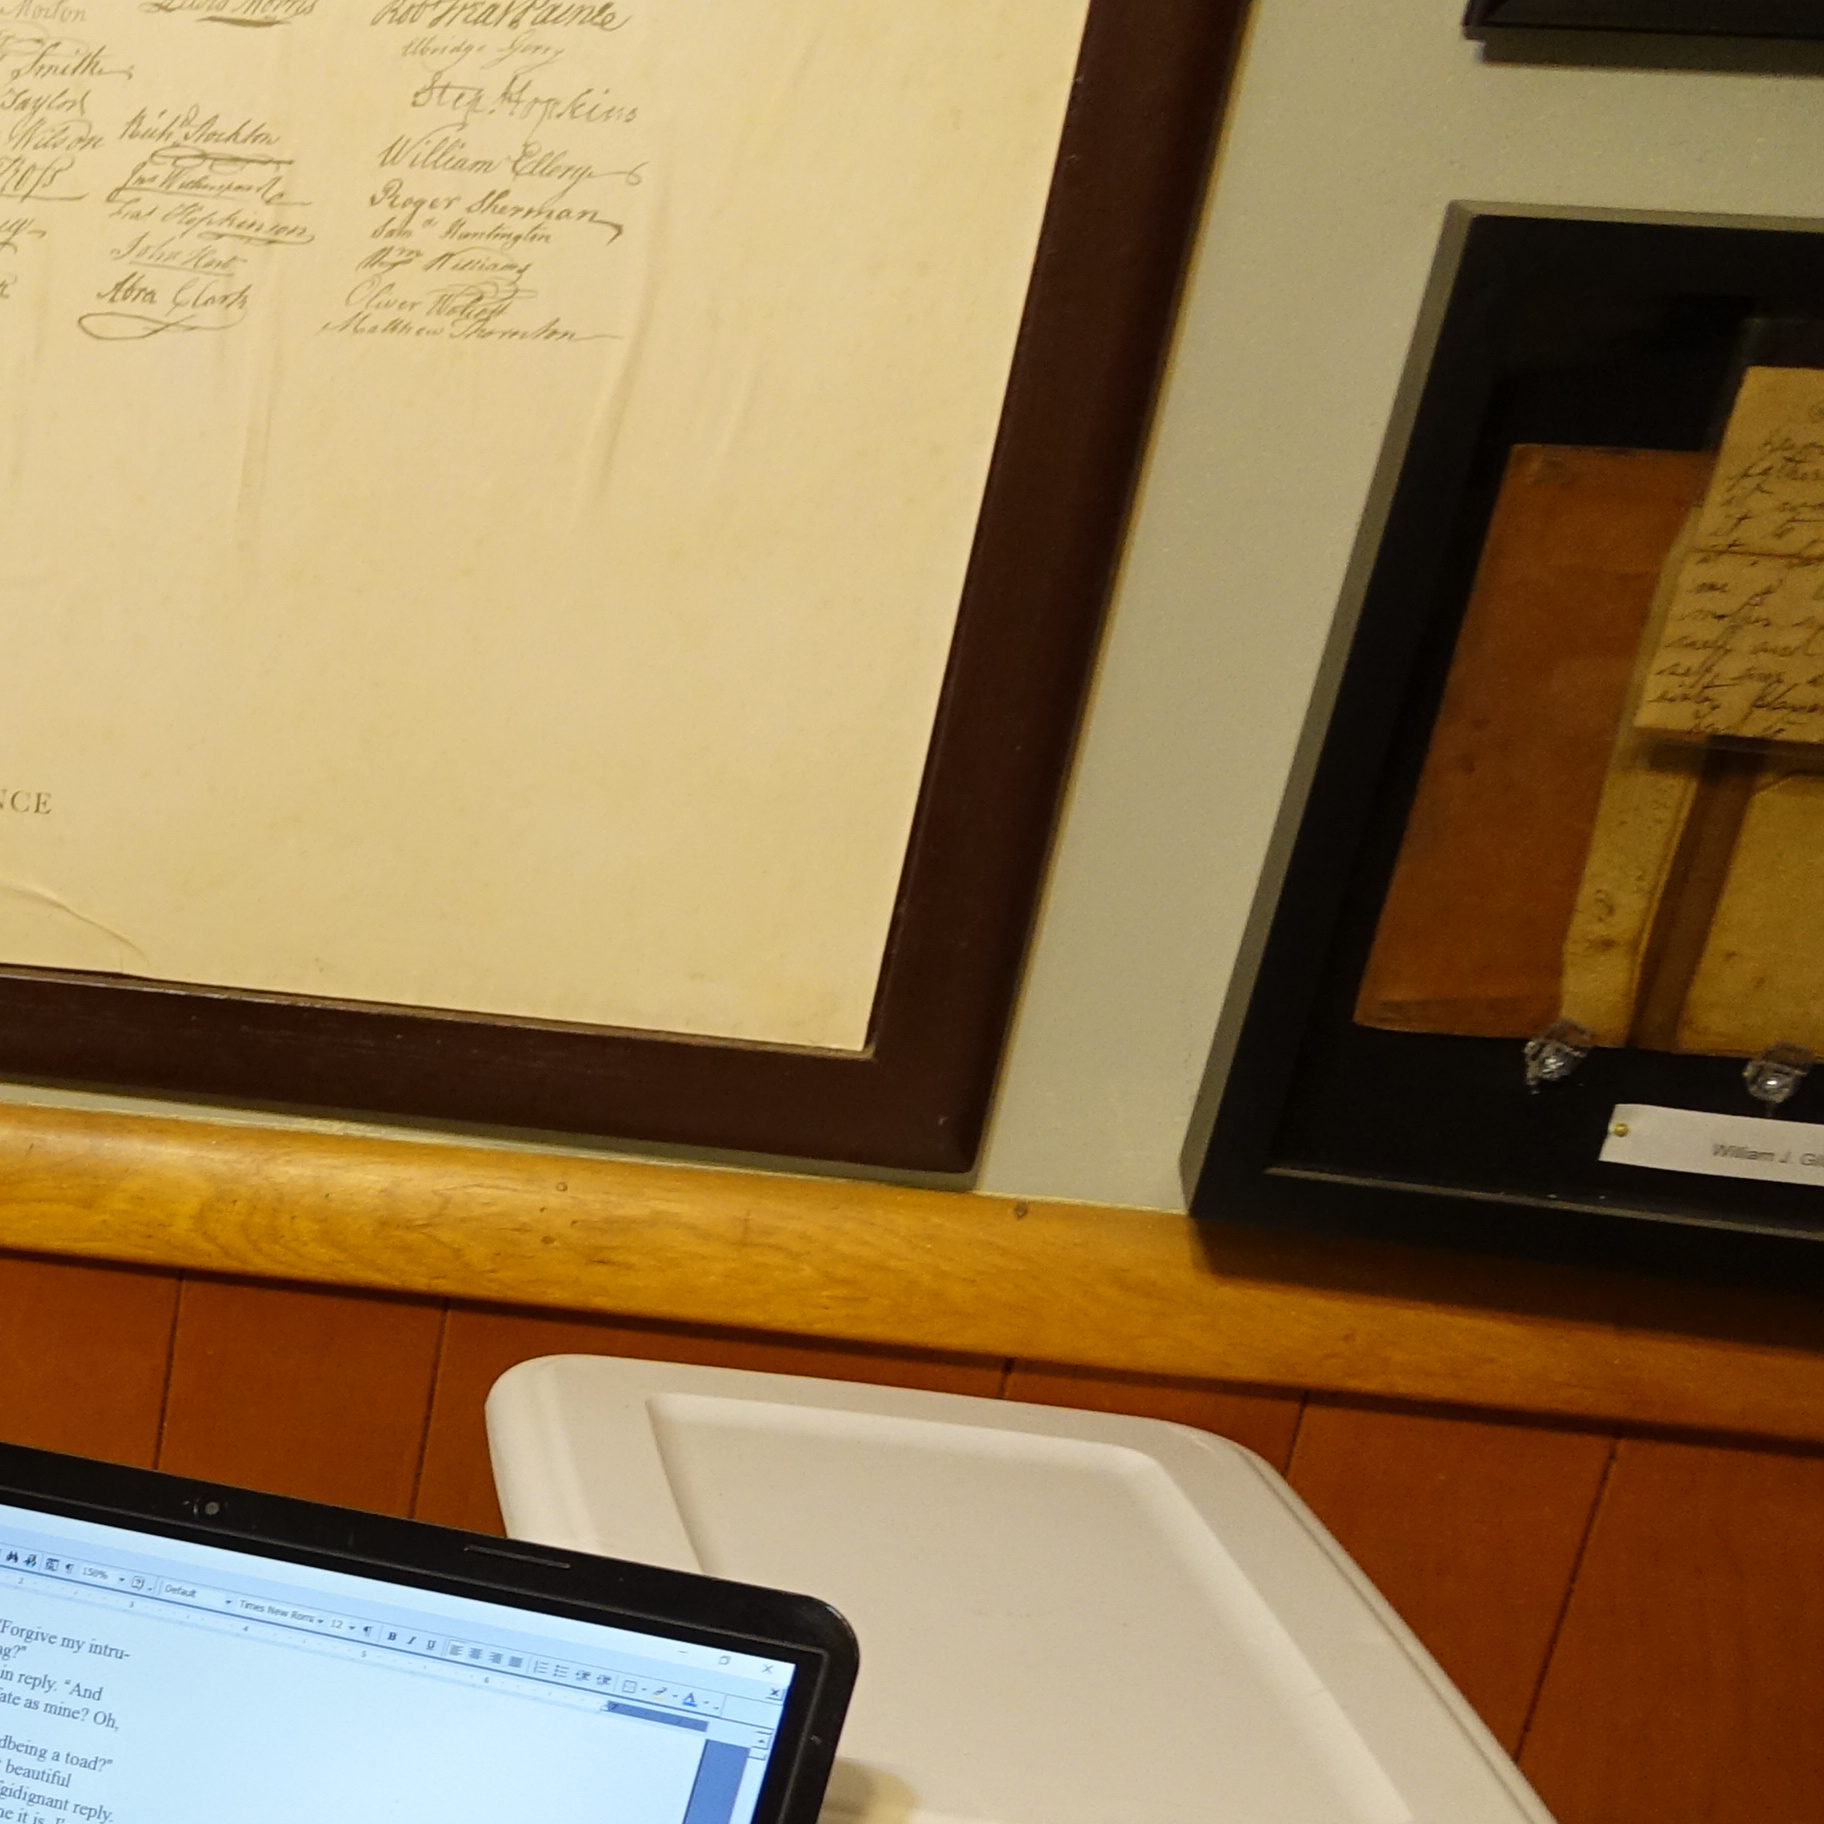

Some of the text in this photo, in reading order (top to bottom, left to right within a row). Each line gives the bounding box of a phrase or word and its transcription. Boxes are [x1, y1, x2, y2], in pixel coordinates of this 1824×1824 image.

[8, 116, 105, 151] Wilson
[379, 123, 506, 175] William
[369, 179, 624, 243] Roger Sherman
[1712, 1143, 1775, 1162] William
[239, 1598, 266, 1614] Times
[267, 1604, 288, 1618] New
[58, 1636, 86, 1654] my
[87, 1637, 131, 1660] intru-
[16, 1672, 58, 1694] reply.
[22, 1697, 41, 1711] as
[42, 1700, 90, 1722] mine?
[92, 1710, 120, 1732] Oh,
[4, 1757, 73, 1789] beautiful
[15, 1807, 29, 1824] it
[71, 1802, 114, 1824] reply.
